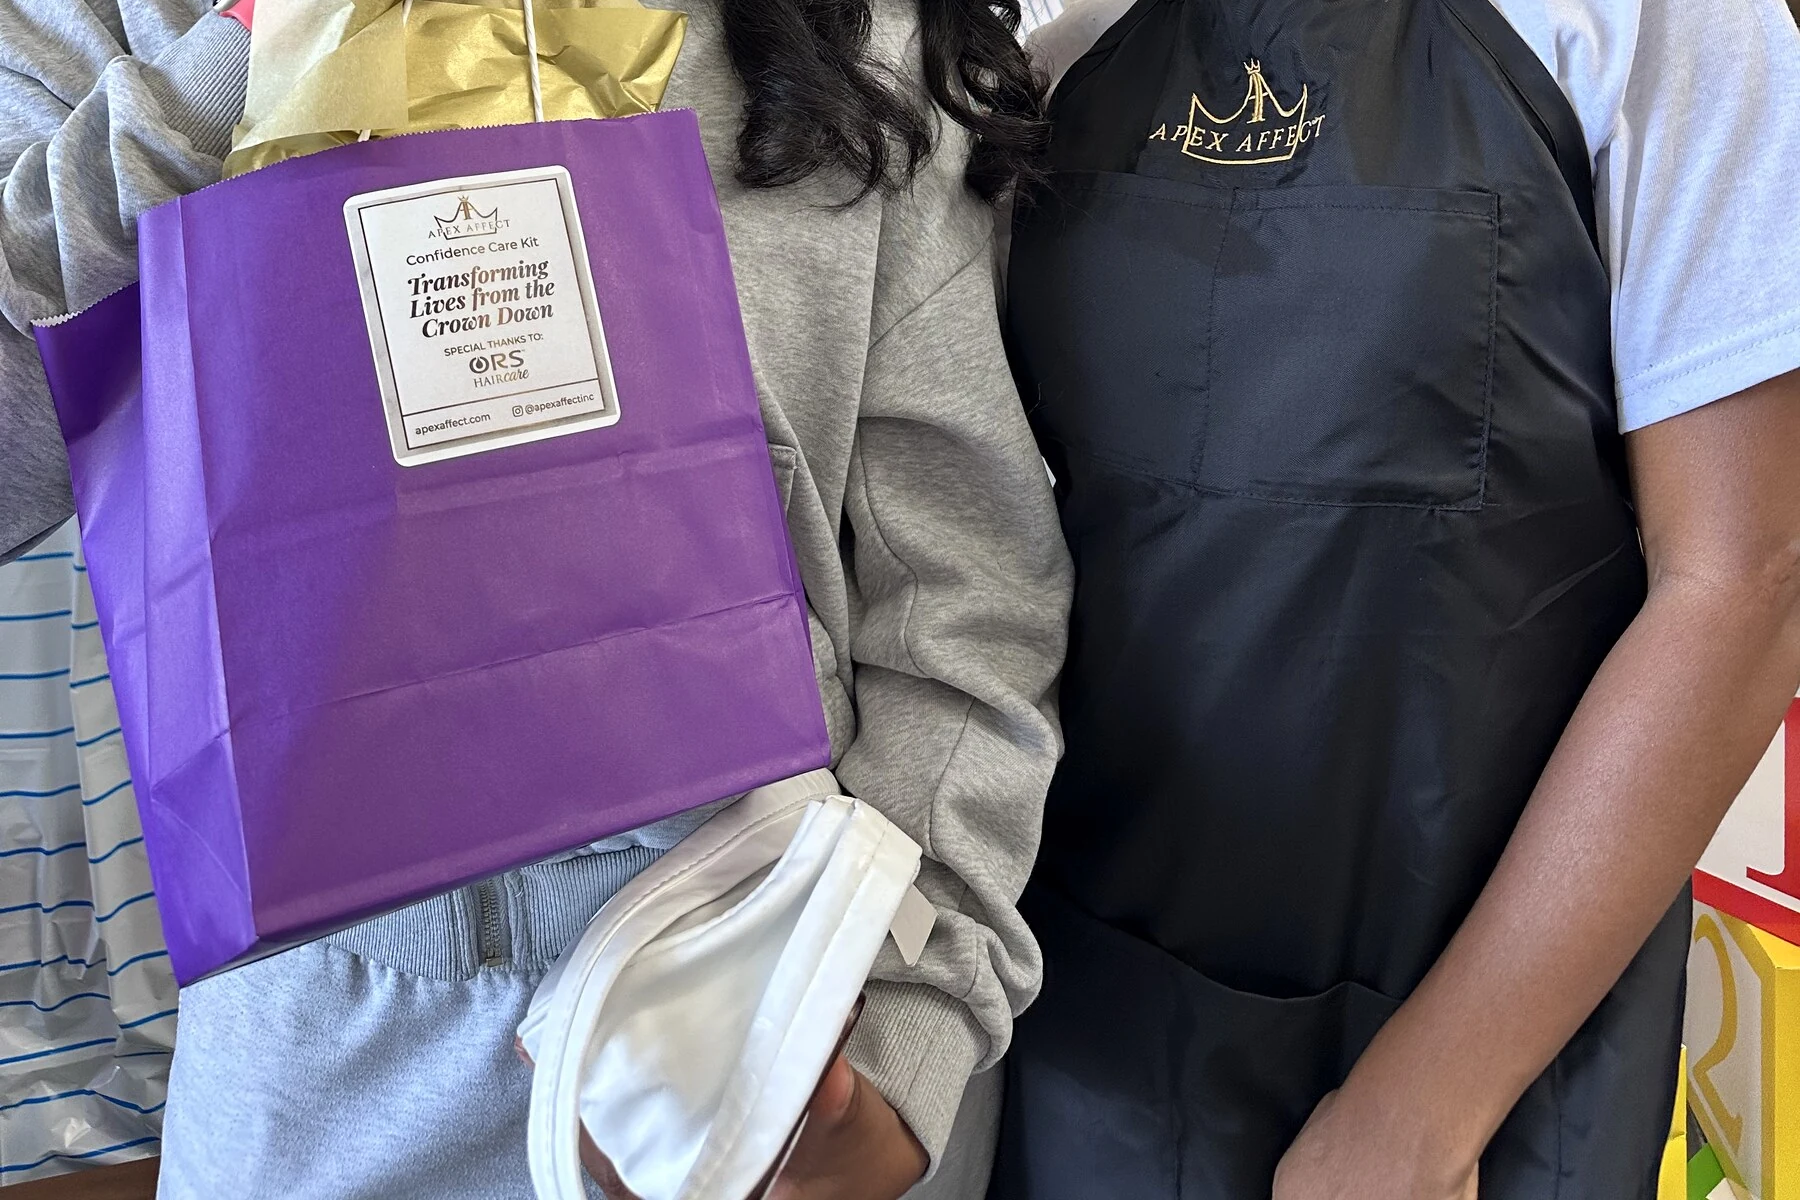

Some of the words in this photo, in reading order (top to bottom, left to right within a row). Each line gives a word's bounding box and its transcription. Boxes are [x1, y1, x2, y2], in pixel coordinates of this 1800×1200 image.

[1149, 123, 1229, 152] APEX
[1236, 115, 1325, 152] AFFECT
[428, 225, 468, 239] APEX
[466, 219, 510, 233] AFFECT
[406, 244, 486, 265] Confidence
[488, 239, 518, 253] Care
[520, 237, 539, 248] Kit
[407, 260, 549, 296] Transforming
[410, 290, 466, 318] Lives
[472, 285, 520, 311] from
[525, 279, 555, 298] the
[422, 315, 492, 338] Crown
[497, 303, 553, 326] Down
[444, 343, 486, 356] SPECIAL
[487, 335, 526, 349] THANKS
[527, 333, 544, 342] TO:
[473, 369, 530, 388] HAIRcare
[415, 412, 491, 435] apexaffect.com
[525, 393, 595, 415] @apexaffectinc
